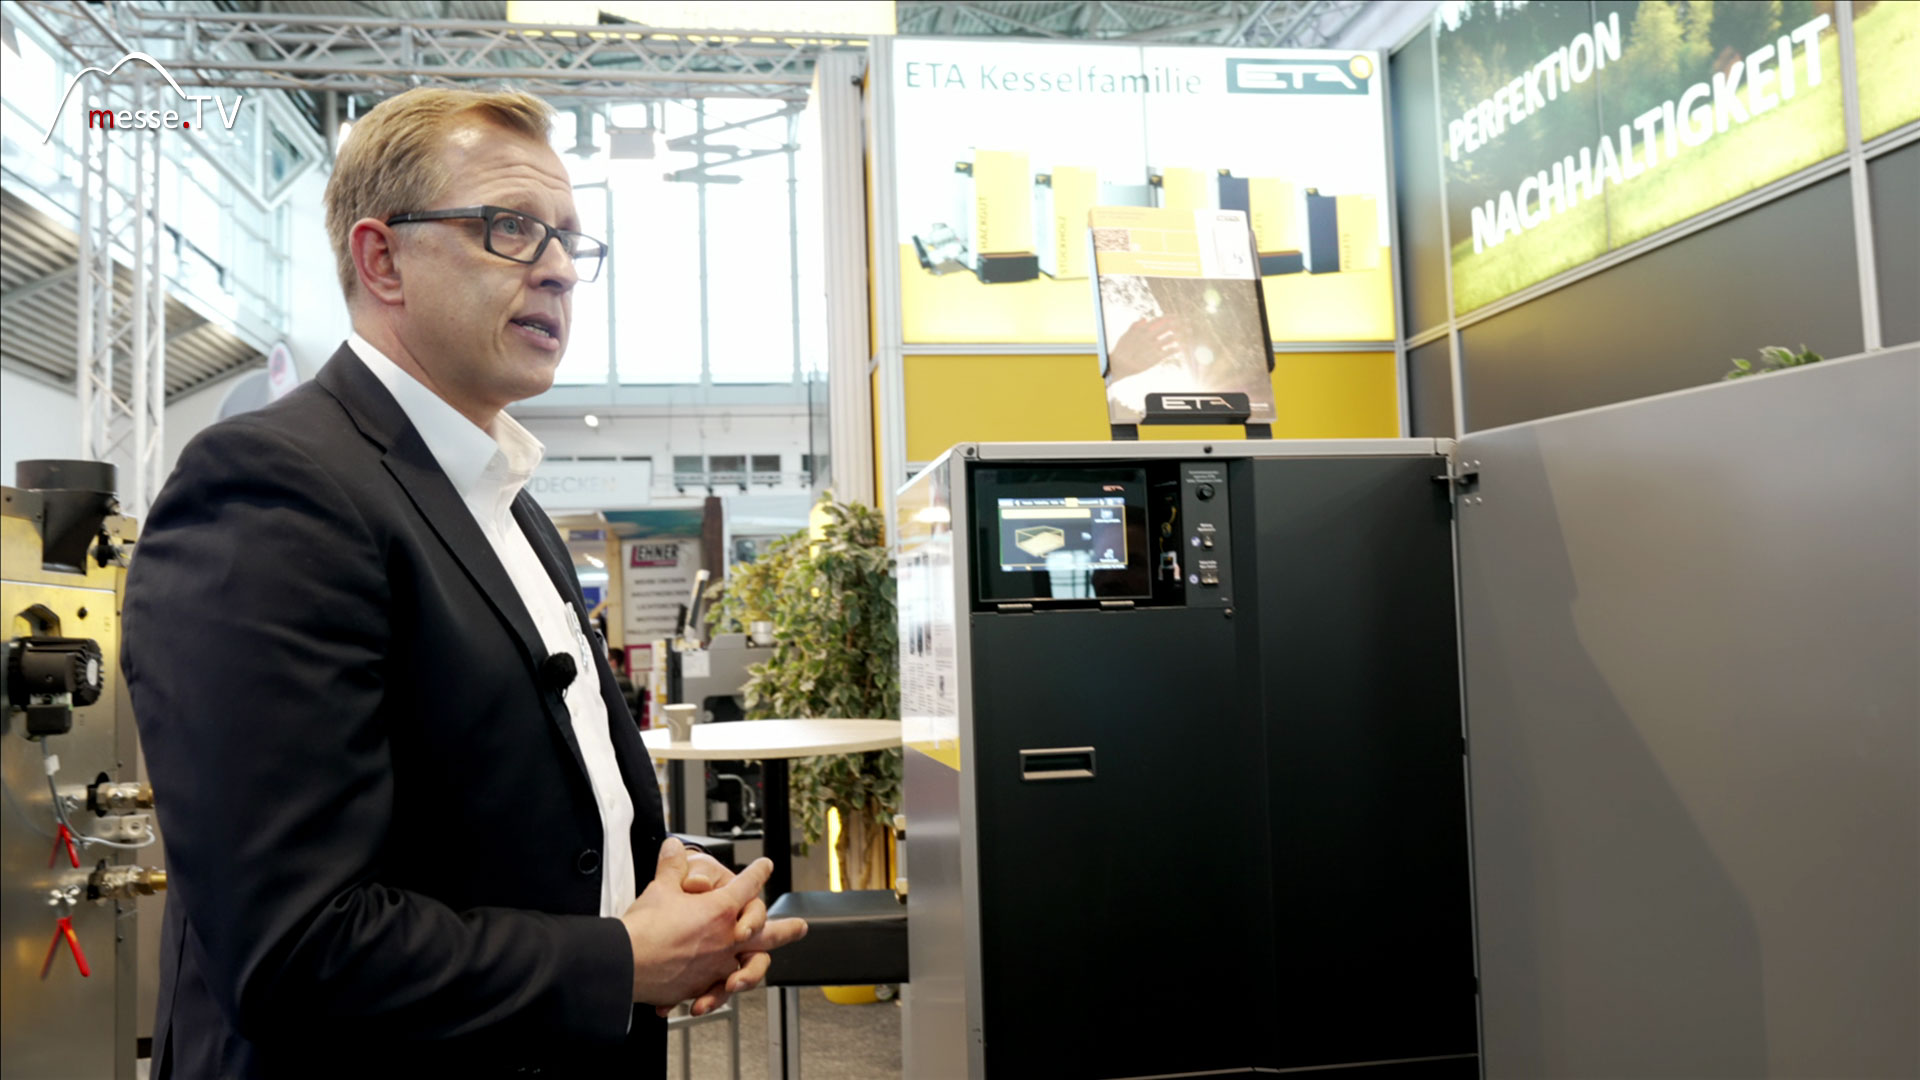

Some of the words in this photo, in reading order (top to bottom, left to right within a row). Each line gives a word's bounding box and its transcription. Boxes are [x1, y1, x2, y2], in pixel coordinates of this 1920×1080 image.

[905, 62, 966, 91] ETA
[979, 62, 1203, 95] Kesselfamilie
[1236, 63, 1358, 91] ETA
[1448, 12, 1622, 162] PERFEKTION
[1469, 13, 1831, 255] NACHHALTIGKEIT
[1161, 396, 1235, 410] ETA
[630, 544, 680, 568] LEHNER
